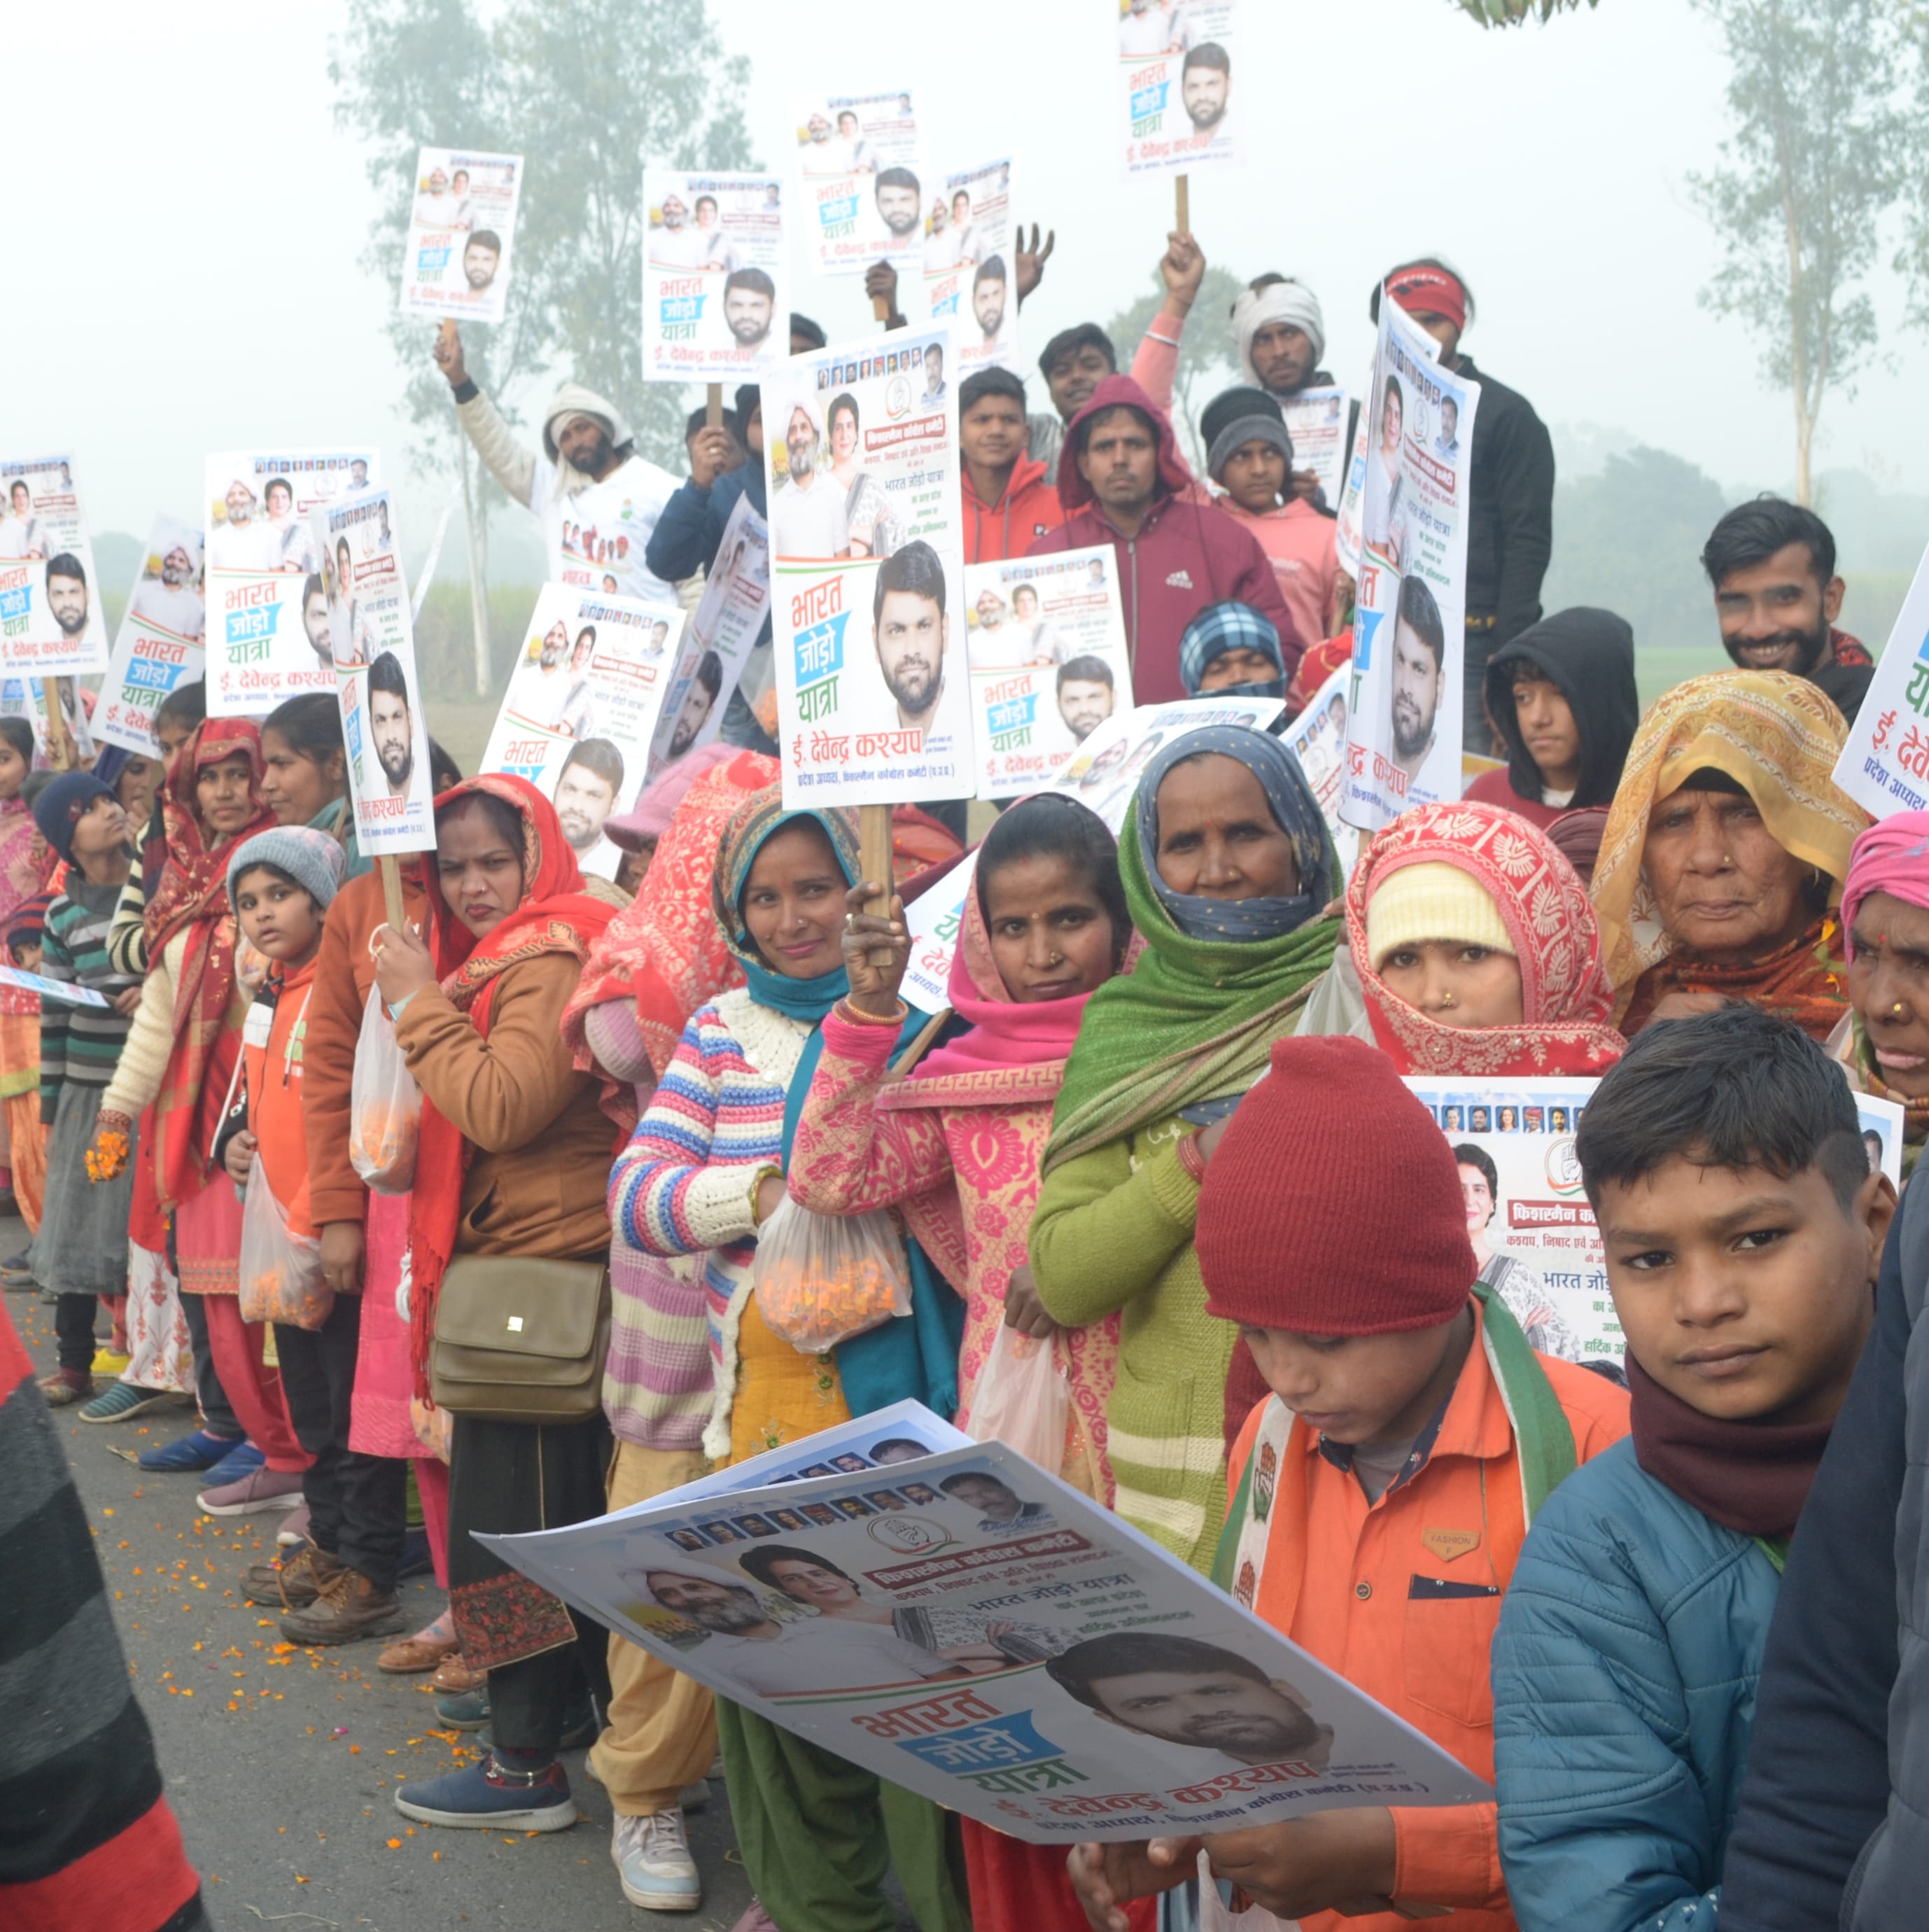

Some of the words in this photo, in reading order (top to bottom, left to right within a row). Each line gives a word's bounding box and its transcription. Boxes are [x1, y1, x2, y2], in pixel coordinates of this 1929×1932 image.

[225, 580, 278, 610] भारत
[792, 574, 843, 629] भारत
[230, 609, 271, 637] जोड़ो
[134, 638, 188, 664] भारत
[226, 637, 272, 664] यात्रा
[797, 624, 836, 675] जोड़ो
[132, 660, 172, 688] जोड़ो
[796, 674, 839, 723] यात्रा
[985, 674, 1031, 704] भारत
[990, 699, 1027, 728] जोड़ो
[504, 740, 549, 764] भारत
[810, 729, 850, 764] देवेन्द्र
[855, 729, 923, 758] कश्यप
[989, 724, 1031, 752] यात्रा
[1513, 1201, 1576, 1222] फिशरमैन
[1542, 1233, 1571, 1247] निषाद
[1542, 1272, 1582, 1289] भारत
[1431, 1534, 1472, 1545] FASHION
[967, 1594, 1026, 1611] भारत
[1023, 1582, 1079, 1600] जोड़ो
[1076, 1574, 1136, 1589] यात्रा
[851, 1688, 1003, 1739] भारत
[917, 1726, 1033, 1765] जोड़ो
[955, 1758, 1092, 1793] यात्रा
[1036, 1792, 1170, 1816] देवेन्द्र
[1165, 1760, 1322, 1805] कश्यप
